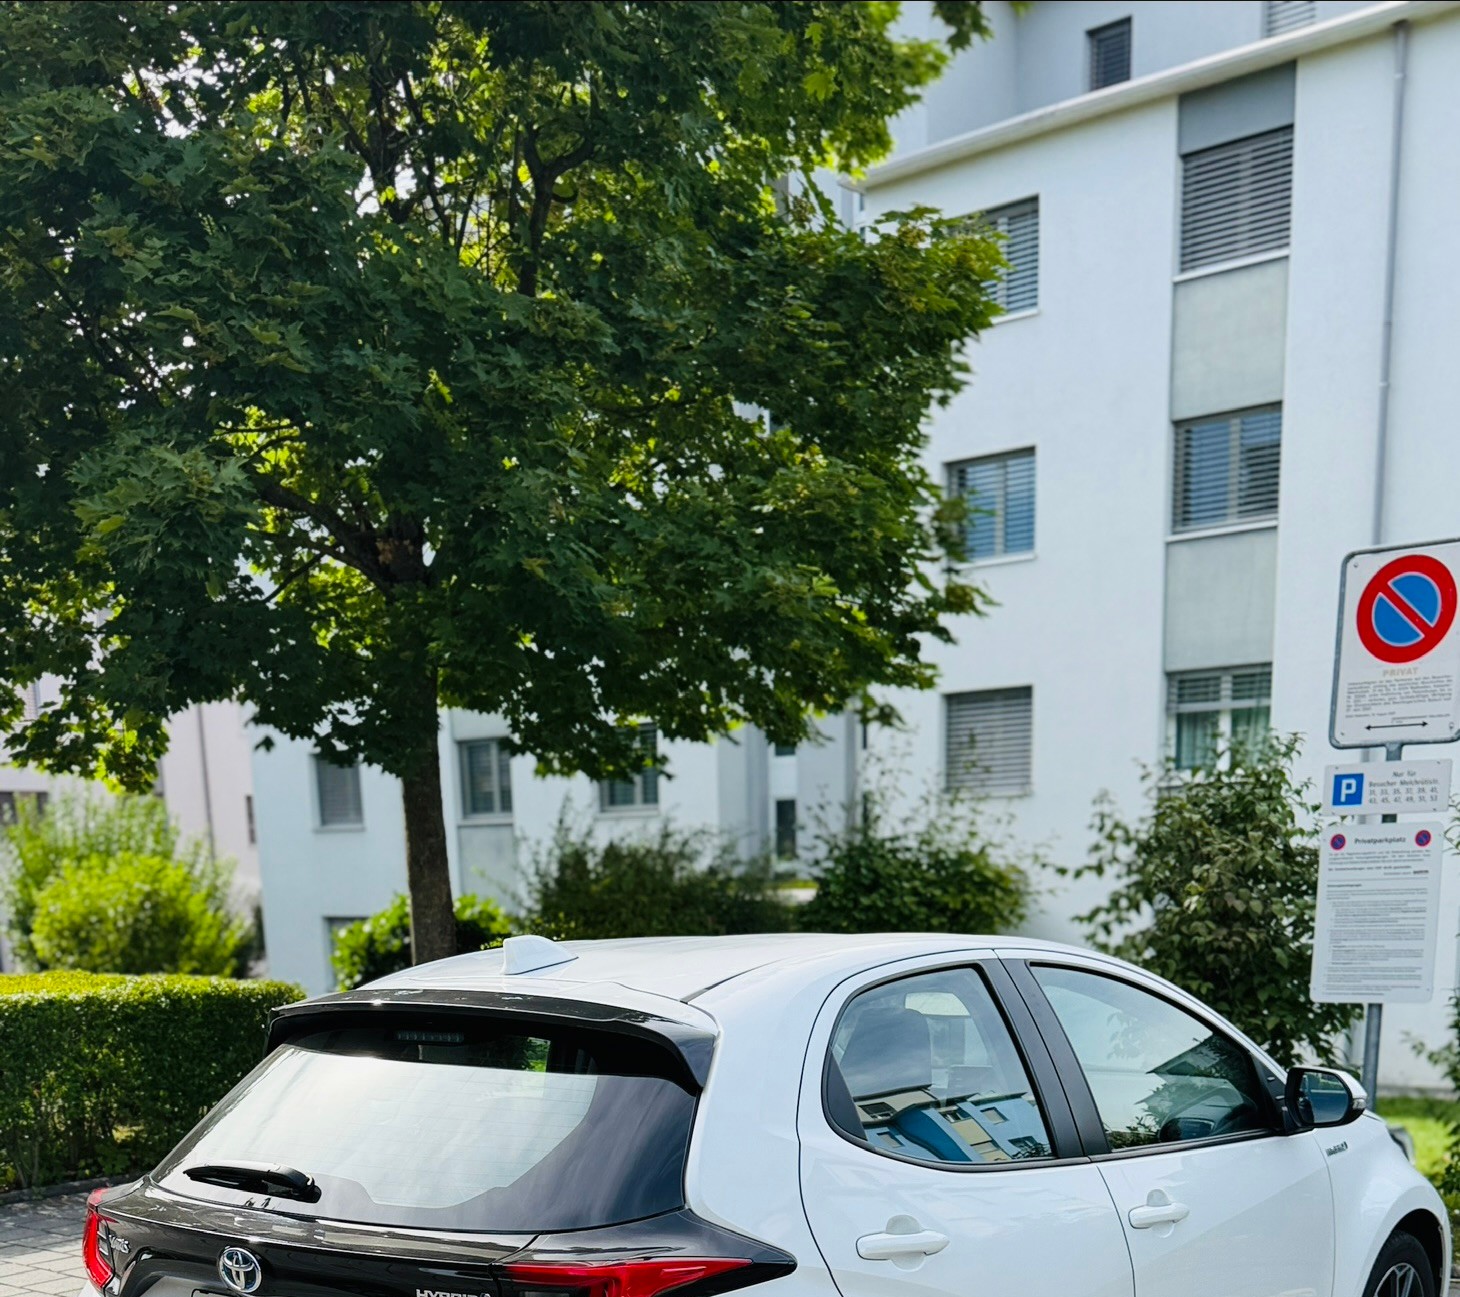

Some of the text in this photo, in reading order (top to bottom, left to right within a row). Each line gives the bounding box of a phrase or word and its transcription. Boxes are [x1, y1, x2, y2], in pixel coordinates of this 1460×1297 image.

[1382, 667, 1419, 677] PRIVAT
[1340, 778, 1357, 803] P
[1354, 837, 1406, 845] Privatparkplatz
